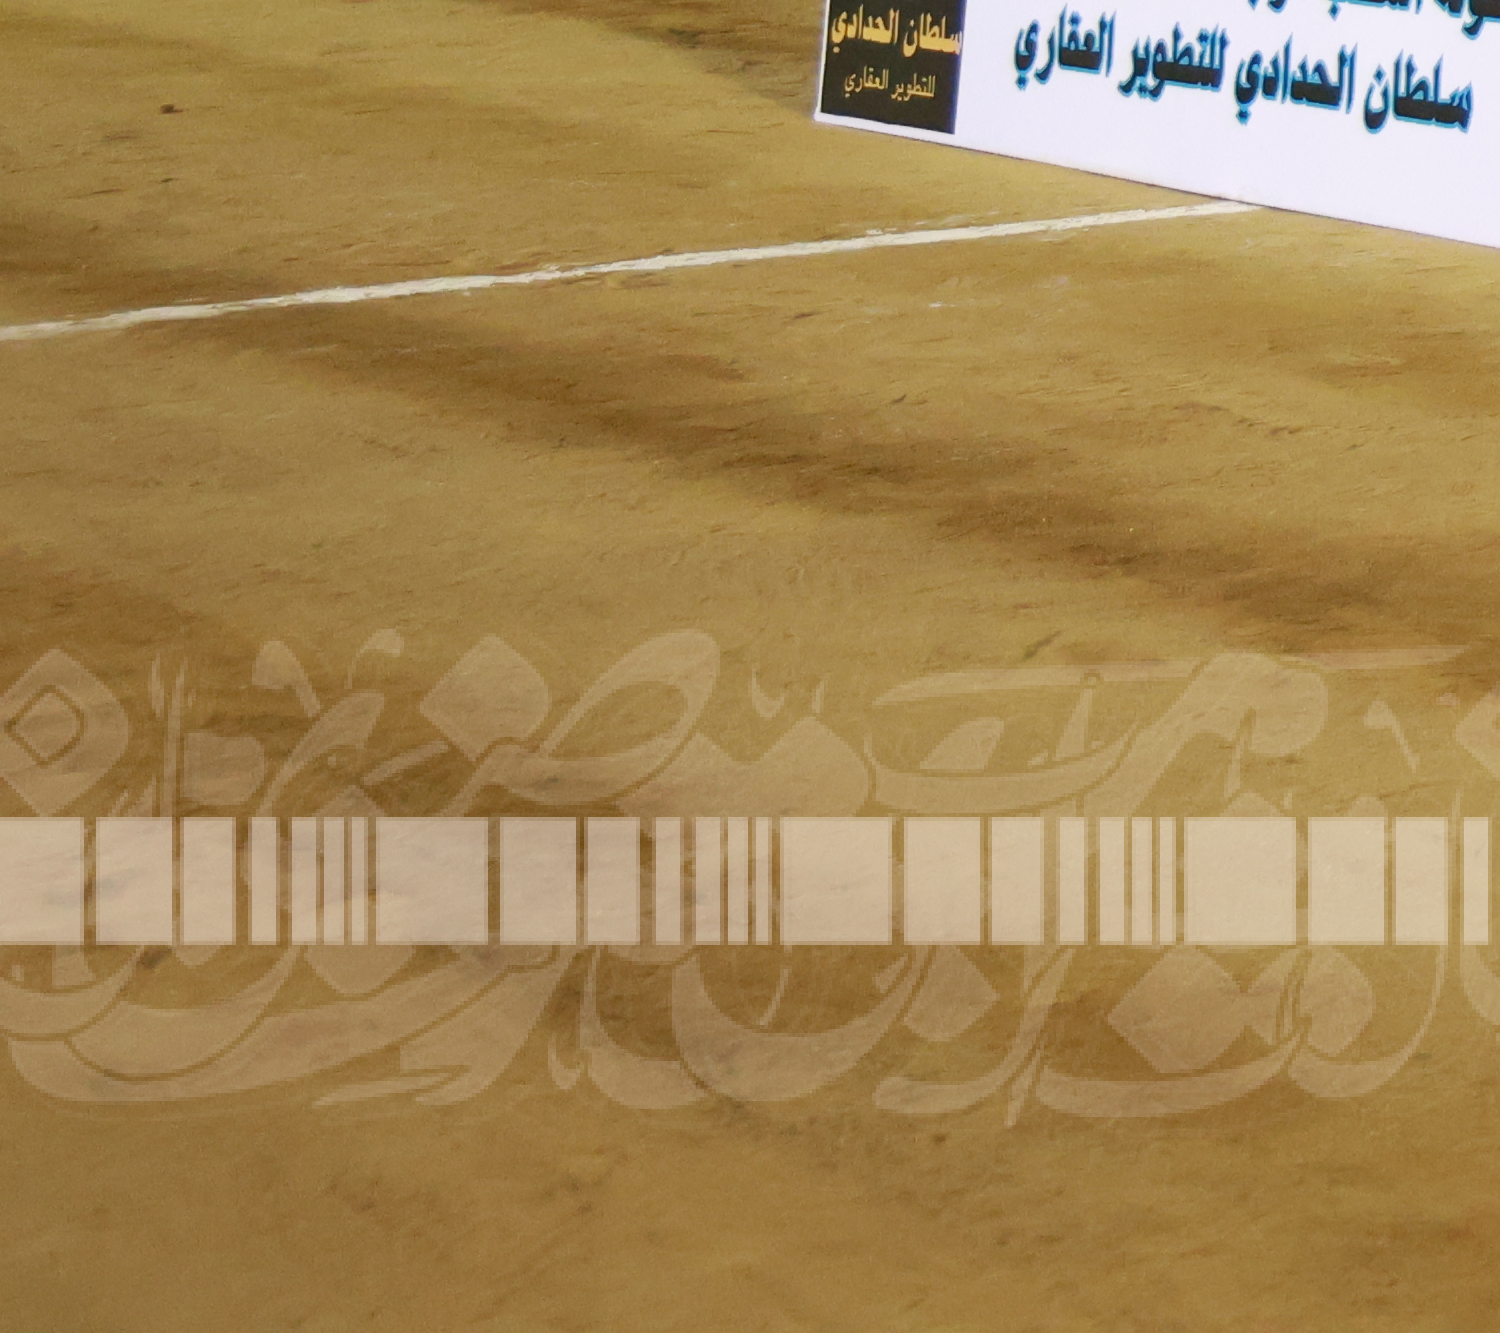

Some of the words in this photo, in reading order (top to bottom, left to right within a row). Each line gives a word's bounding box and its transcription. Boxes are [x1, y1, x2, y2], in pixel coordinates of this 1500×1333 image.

[831, 5, 899, 54] الحدادي
[902, 12, 962, 58] سلطان
[1015, 3, 1116, 91] العقاري
[843, 66, 889, 97] العقاري
[891, 75, 936, 101] للتطوير
[1118, 23, 1230, 100] للتطوير
[1235, 32, 1358, 125] الحدادي
[1363, 49, 1473, 133] سلطان
